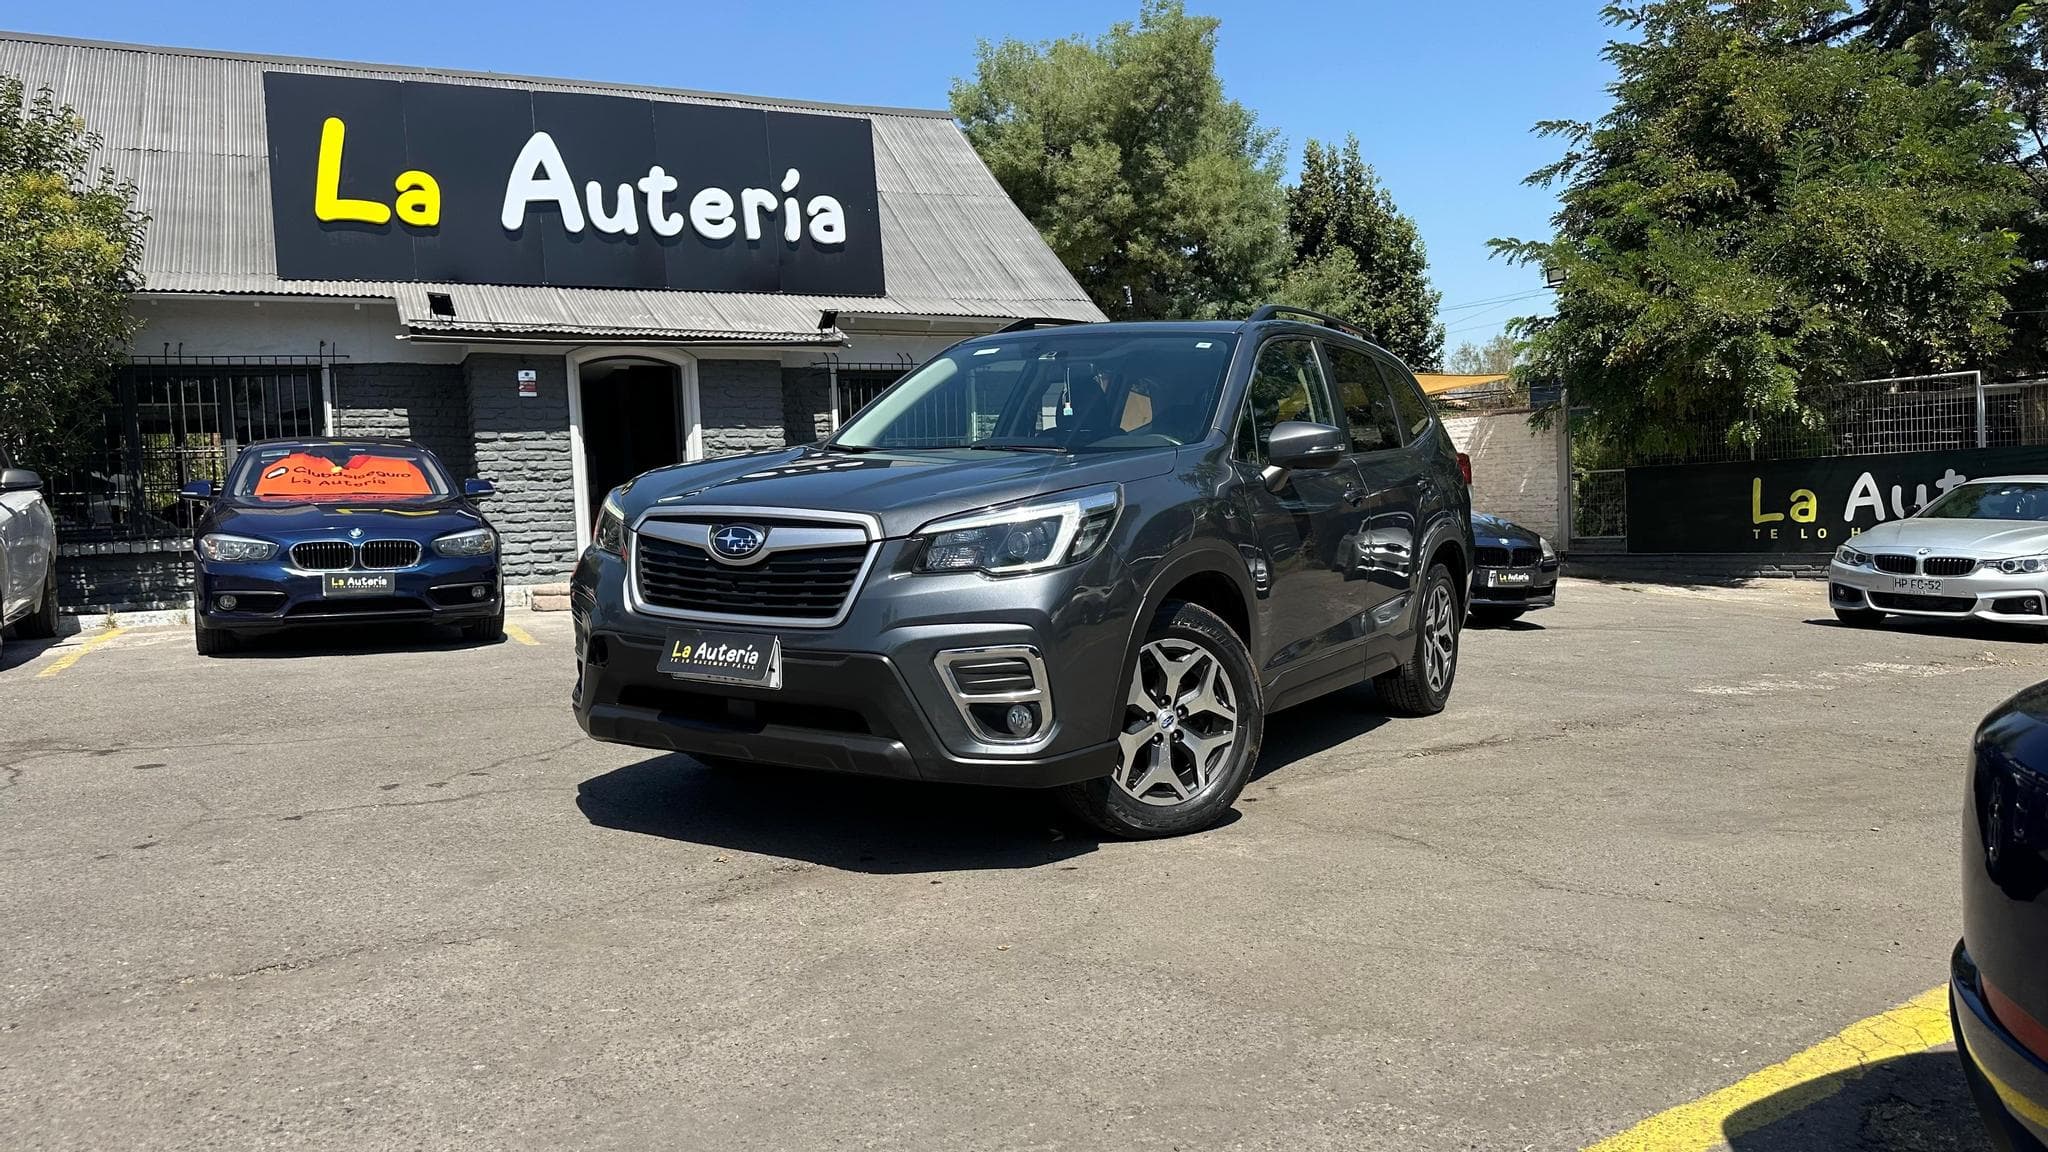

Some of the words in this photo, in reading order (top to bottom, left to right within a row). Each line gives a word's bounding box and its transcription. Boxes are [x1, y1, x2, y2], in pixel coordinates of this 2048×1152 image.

[314, 117, 441, 226] La
[501, 131, 847, 244] Autería
[291, 476, 311, 484] La
[1752, 477, 1817, 524] La
[1752, 528, 1779, 540] TE
[1800, 527, 1828, 540] LO
[331, 577, 344, 586] La
[347, 576, 387, 586] Autería
[672, 640, 692, 658] La
[694, 642, 759, 664] Autería
